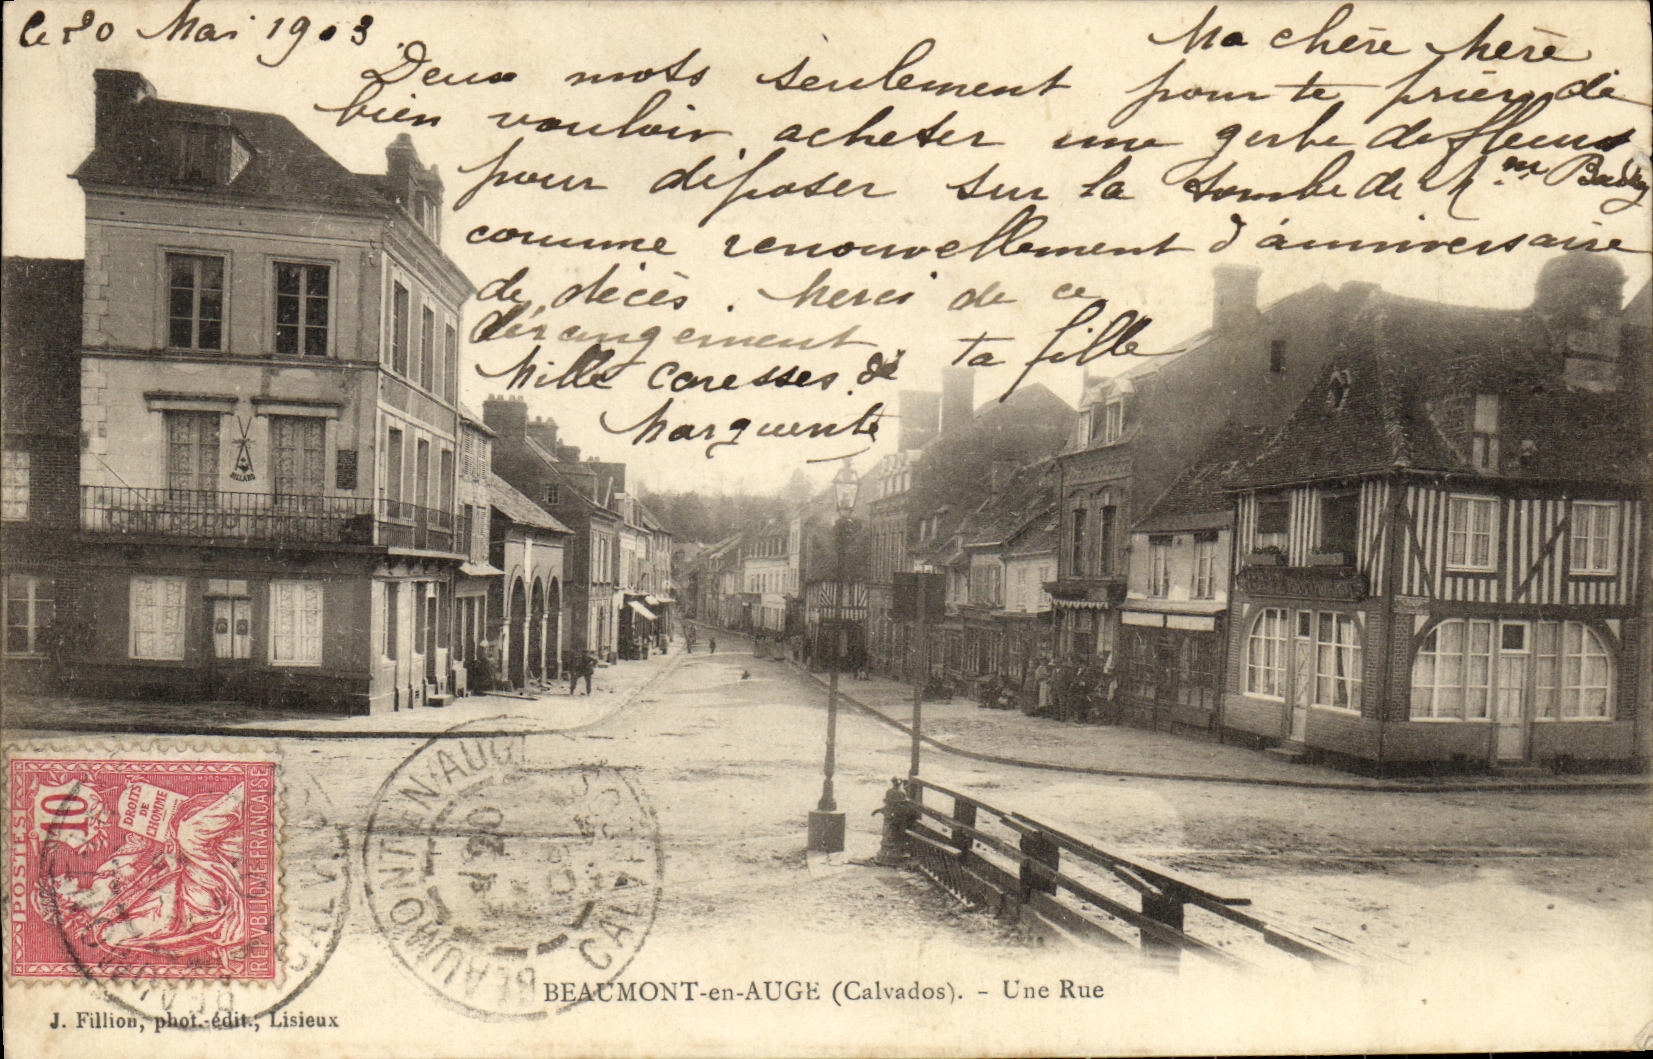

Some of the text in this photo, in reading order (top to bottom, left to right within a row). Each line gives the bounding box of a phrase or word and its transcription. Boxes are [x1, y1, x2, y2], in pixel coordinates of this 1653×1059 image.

[1148, 5, 1248, 51] Ma
[361, 40, 517, 84] Deux
[565, 48, 710, 86] mots
[756, 37, 1073, 97] seulement
[1108, 59, 1268, 129] pour
[1278, 71, 1364, 103] te
[314, 83, 441, 127] bien
[488, 89, 732, 143] vouloir
[774, 106, 1005, 148] acheter
[1052, 131, 1172, 150] une
[453, 137, 607, 211] pour
[649, 147, 897, 225] déposer
[946, 163, 1049, 201] sur
[1080, 163, 1131, 200] la
[1354, 167, 1404, 200] de
[466, 226, 677, 255] comme
[722, 206, 1195, 262] renouvellement
[476, 266, 529, 303] de
[946, 281, 1020, 312] de
[1053, 282, 1106, 300] ce
[952, 332, 1015, 366] ta
[1000, 299, 1186, 402] fille
[39, 793, 89, 838] 10
[123, 785, 142, 827] DROITS
[139, 802, 150, 817] DE
[13, 814, 27, 915] POSTES
